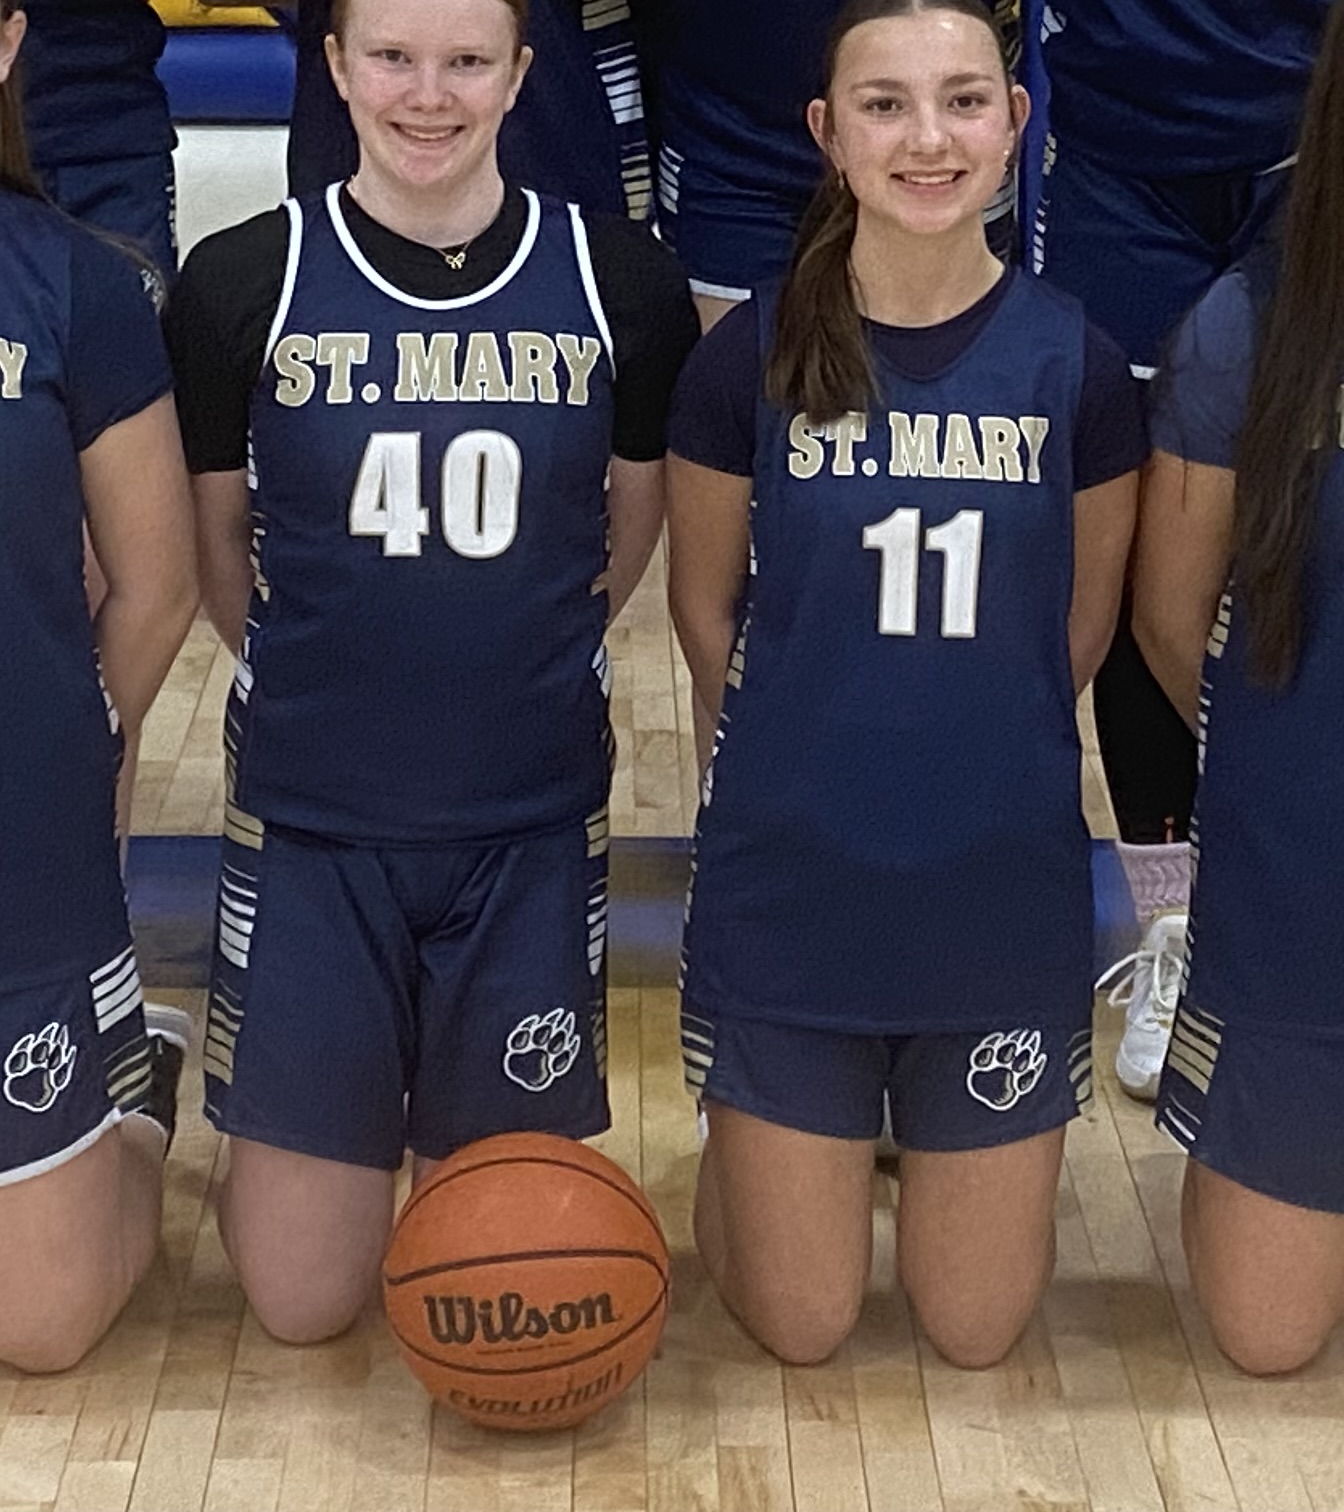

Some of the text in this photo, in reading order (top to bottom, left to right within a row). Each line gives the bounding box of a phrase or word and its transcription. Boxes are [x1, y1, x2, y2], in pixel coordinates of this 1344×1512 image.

[273, 331, 601, 407] ST. MARY
[787, 410, 1050, 484] ST. MARY
[348, 428, 523, 560] 40
[862, 507, 984, 639] 11
[423, 1291, 622, 1345] Wilson
